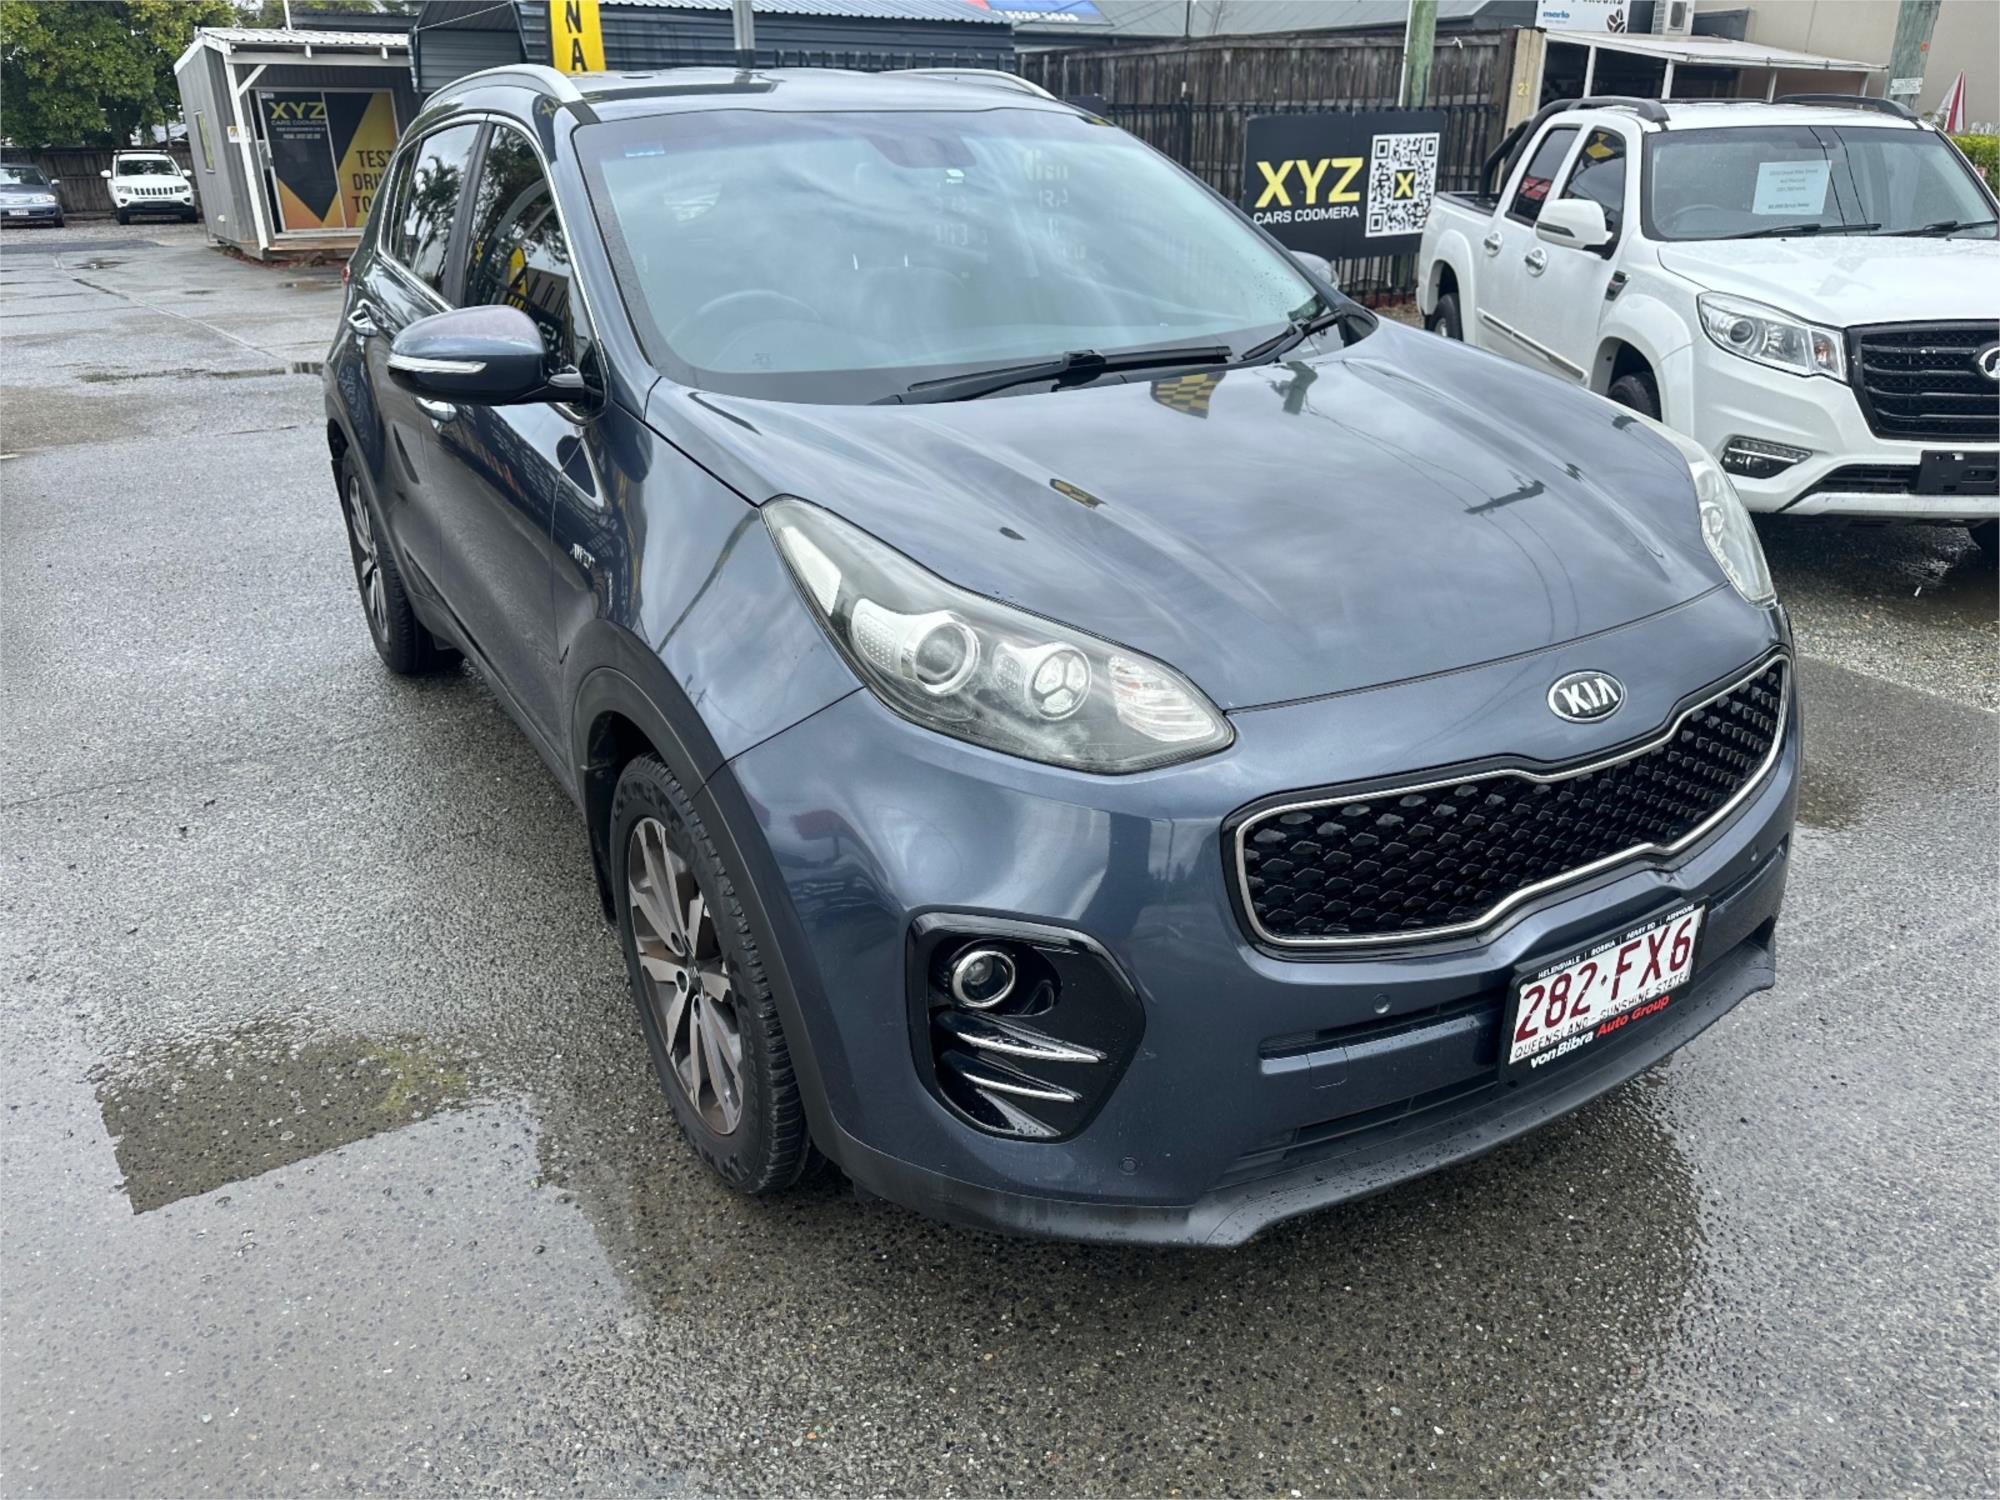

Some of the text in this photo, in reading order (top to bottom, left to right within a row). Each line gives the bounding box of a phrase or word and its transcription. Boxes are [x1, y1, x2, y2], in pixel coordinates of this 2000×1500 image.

[268, 102, 326, 119] XYZ
[1255, 157, 1364, 208] XYZ
[1253, 206, 1359, 225] CARS COOMERA
[1559, 678, 1619, 714] KIA
[1514, 1017, 1589, 1058] QUEENSLAND
[1600, 988, 1650, 1019] SUNSHINE
[1596, 1016, 1629, 1038] Auto
[1632, 995, 1670, 1019] Group
